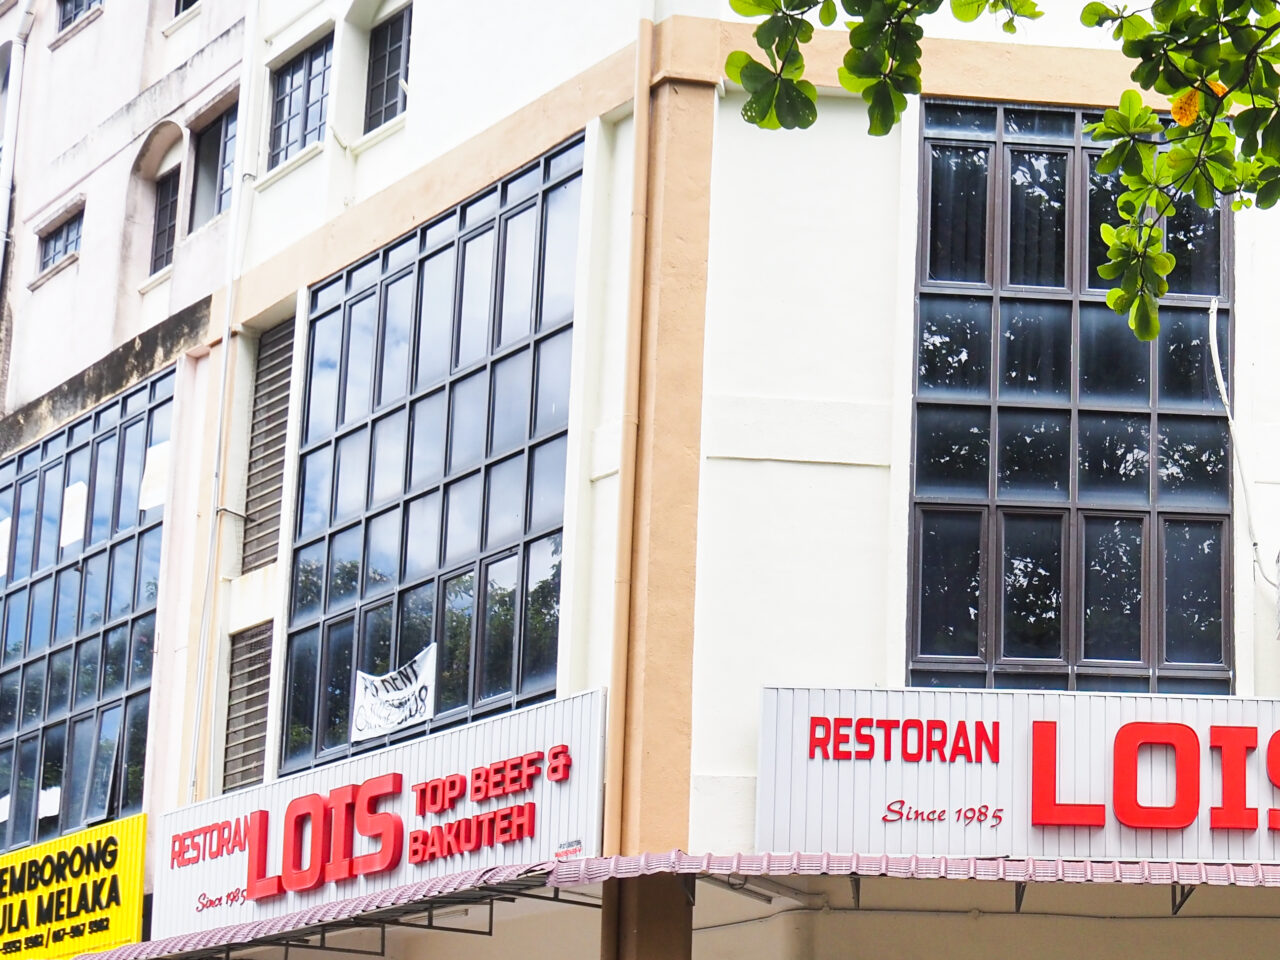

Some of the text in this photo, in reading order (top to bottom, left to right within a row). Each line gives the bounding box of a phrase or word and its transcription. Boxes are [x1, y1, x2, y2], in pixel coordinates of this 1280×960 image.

[808, 716, 1000, 764] RESTORAN
[411, 744, 573, 817] TOP BEEF &
[246, 772, 404, 902] LOIS
[408, 802, 536, 865] BAKUTEH
[881, 799, 1005, 829] Since 1985
[170, 815, 250, 869] RESTORAN
[36, 874, 121, 926] MELAKA
[195, 888, 248, 912] Since 1985
